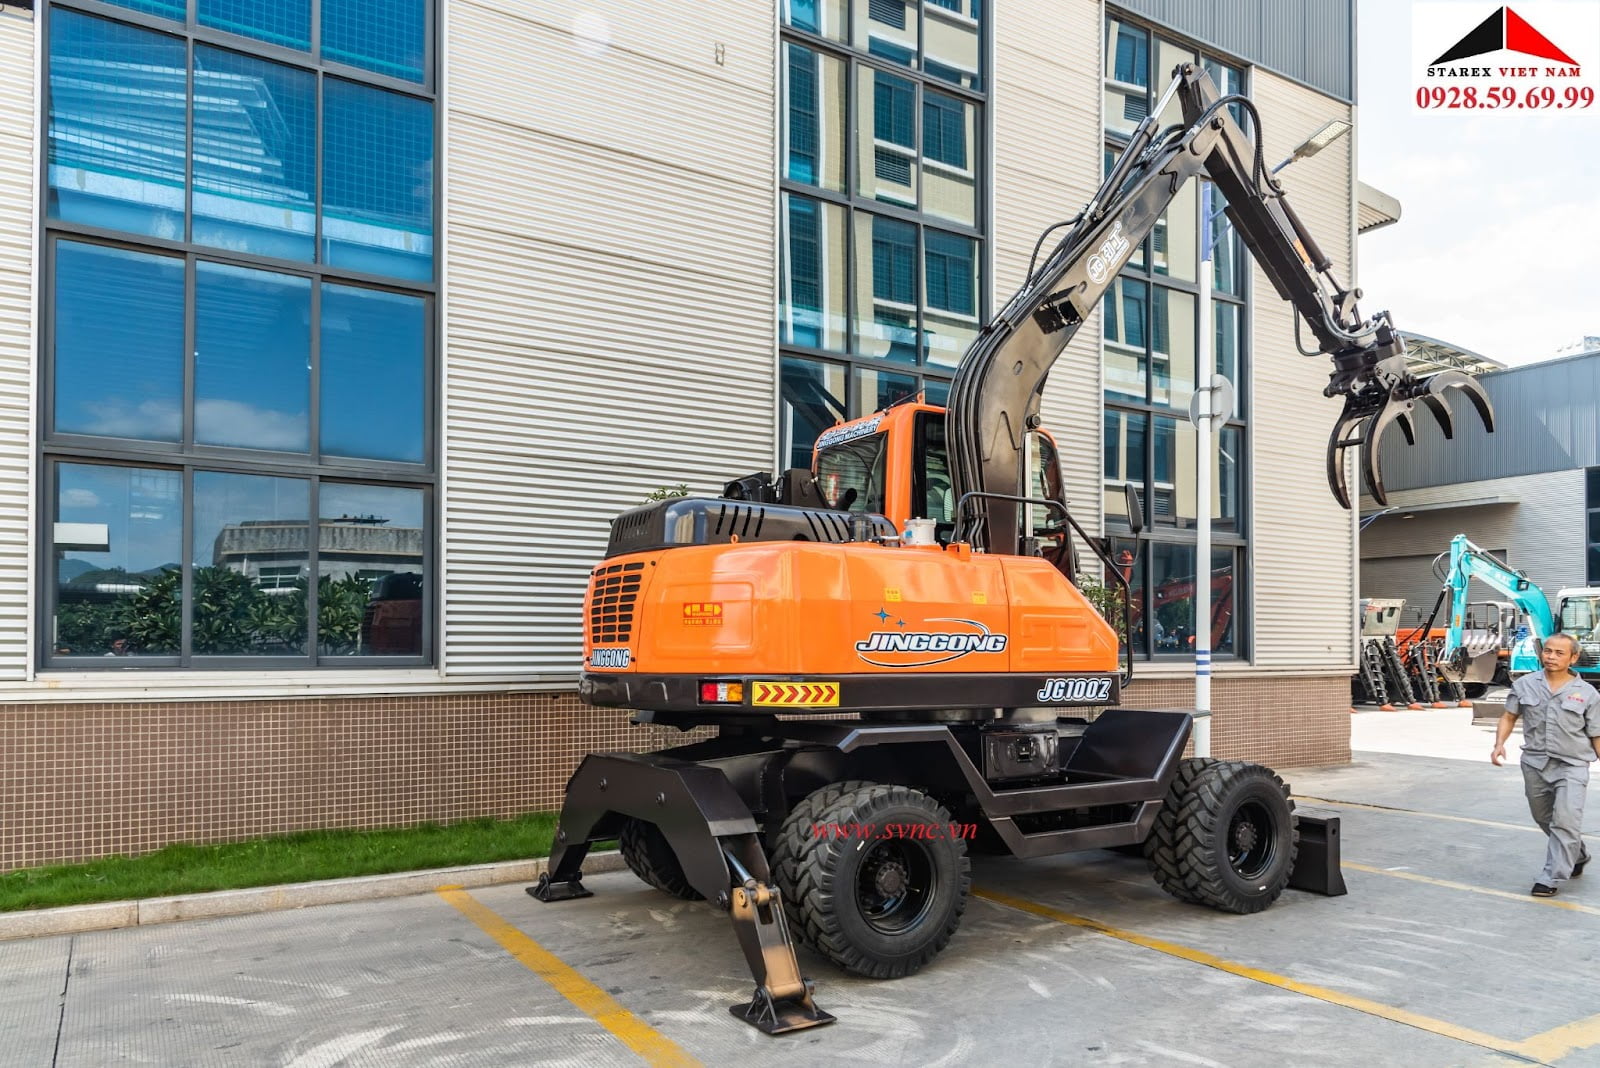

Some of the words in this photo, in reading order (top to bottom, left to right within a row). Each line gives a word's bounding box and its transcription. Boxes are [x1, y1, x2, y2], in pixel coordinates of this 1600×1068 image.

[856, 633, 1007, 652] JINGGONG
[590, 648, 631, 669] JINGGONG
[1037, 678, 1112, 702] JG100Z
